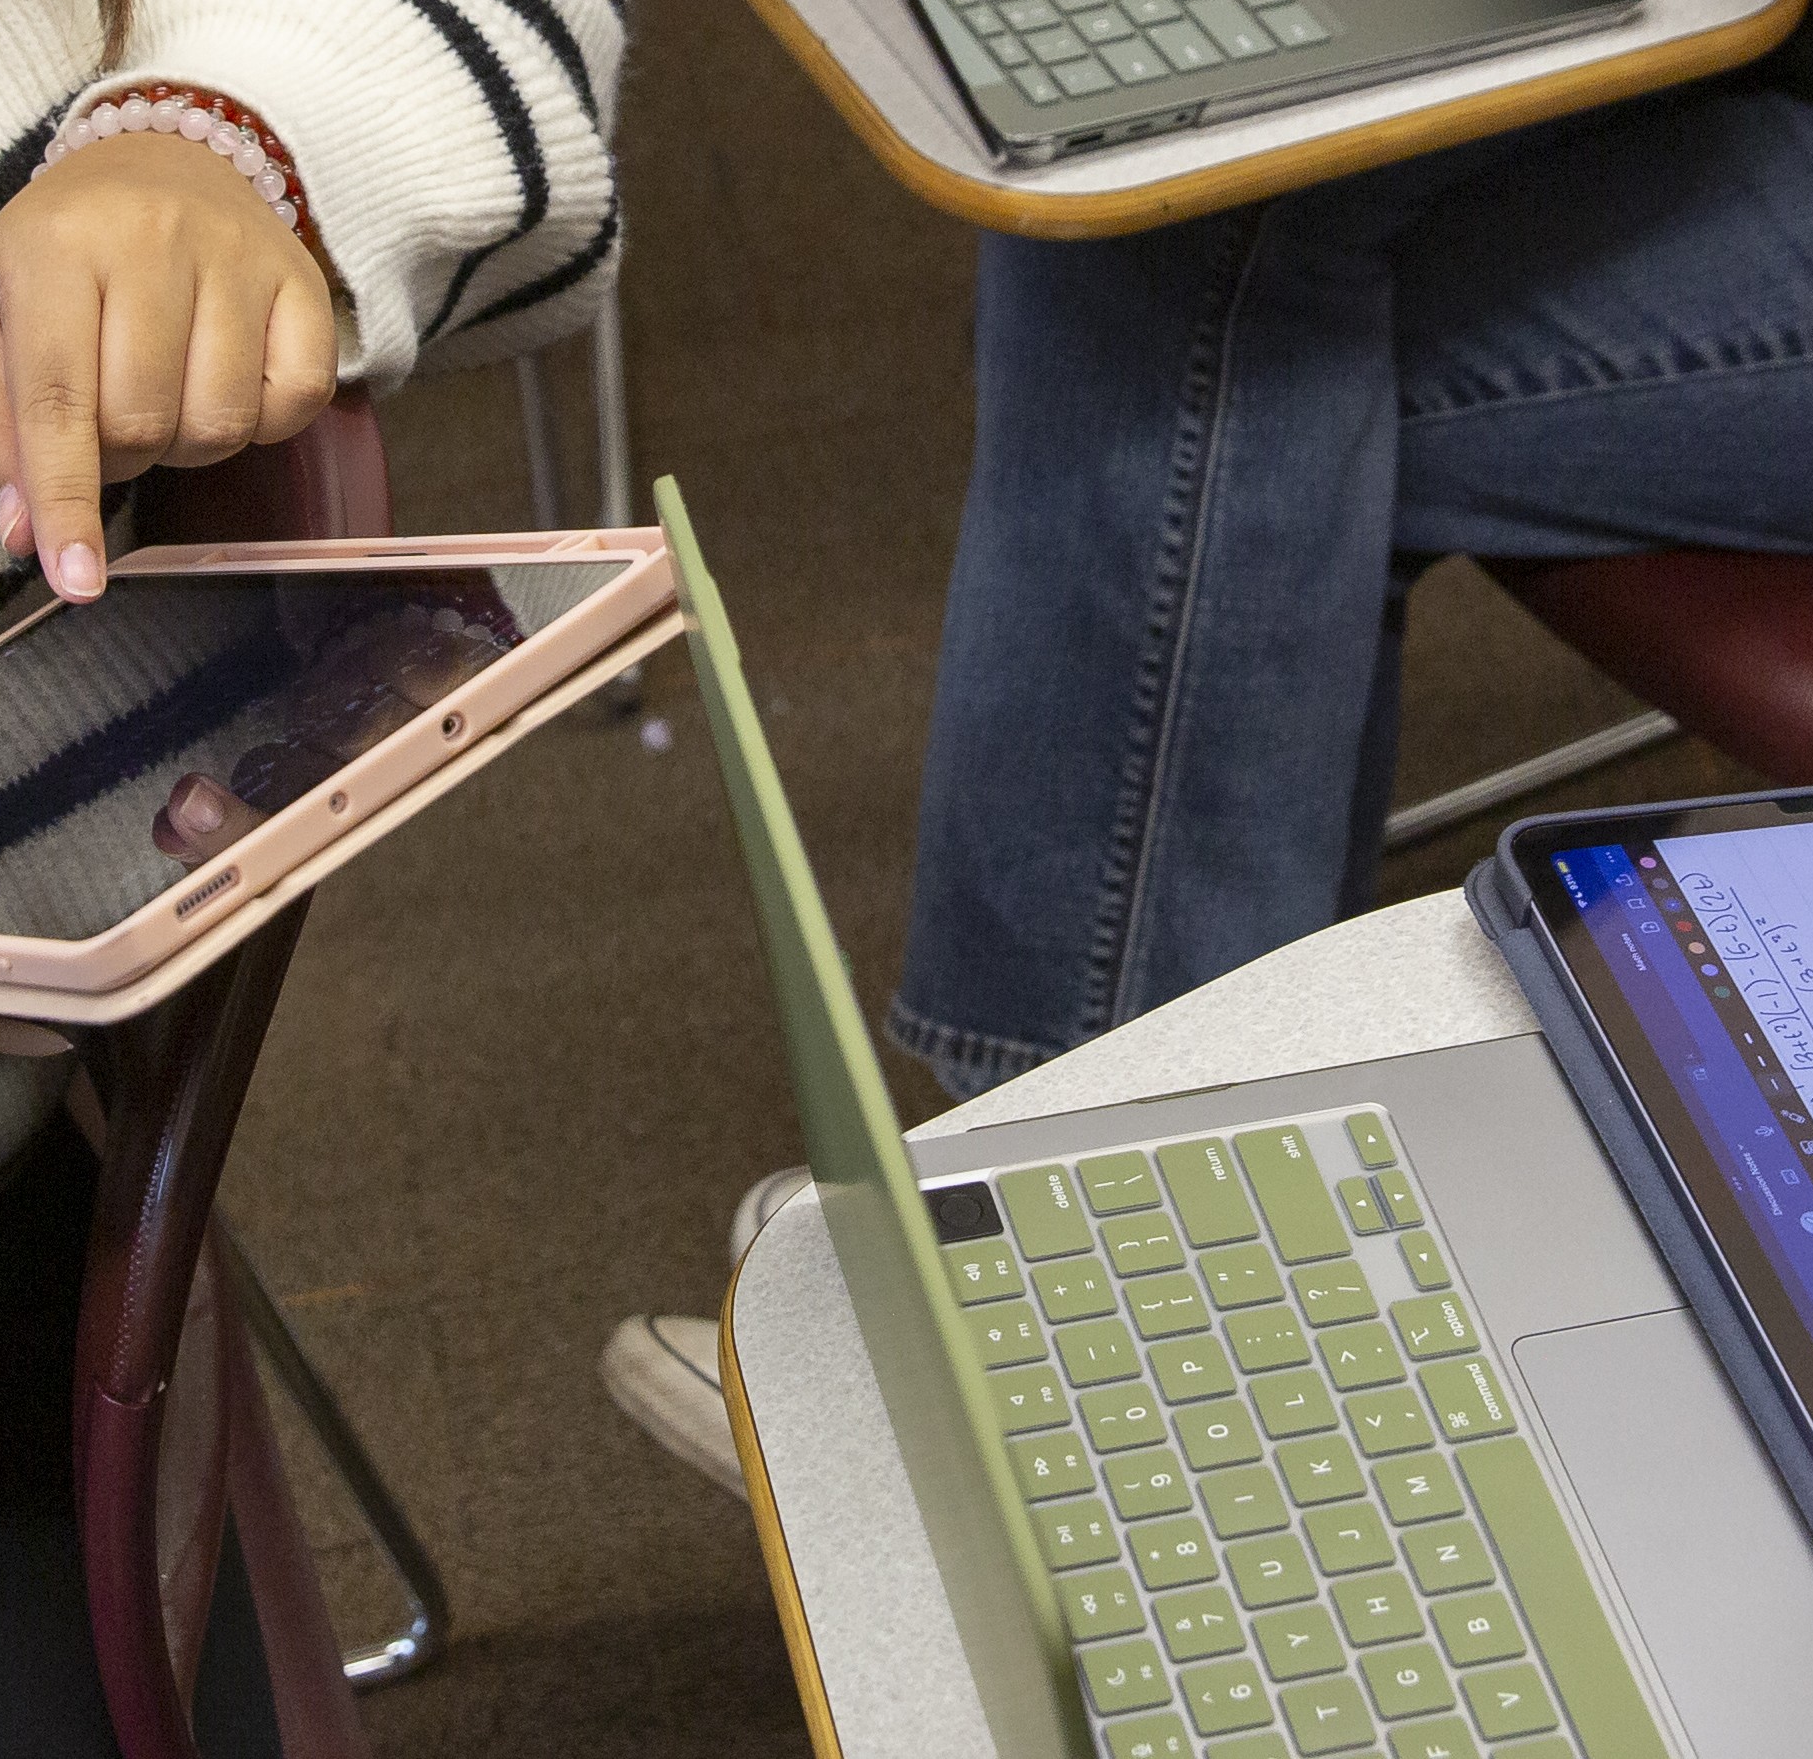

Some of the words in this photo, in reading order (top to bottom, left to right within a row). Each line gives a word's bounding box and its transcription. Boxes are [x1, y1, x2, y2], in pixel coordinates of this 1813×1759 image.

[1621, 933, 1637, 953] notes
[1632, 952, 1647, 971] Math
[1281, 1135, 1300, 1159] shift
[1205, 1147, 1227, 1180] return
[1743, 1152, 1761, 1176] Notes
[1048, 1174, 1069, 1209] delete
[1755, 1175, 1783, 1216] Discussion
[996, 1260, 1008, 1275] F12
[1441, 1300, 1465, 1337] option
[1018, 1323, 1030, 1336] F11
[1182, 1361, 1203, 1373] P
[1040, 1386, 1054, 1402] F10
[1465, 1363, 1503, 1420] command
[1285, 1394, 1304, 1407] L
[1126, 1407, 1146, 1420] 0
[1207, 1424, 1228, 1438] O
[1065, 1455, 1077, 1467] F9
[1310, 1460, 1332, 1475] K
[1151, 1474, 1171, 1487] 9
[1406, 1476, 1430, 1495] M
[1089, 1522, 1102, 1535] F8
[1338, 1530, 1360, 1539] J
[1176, 1541, 1197, 1555] 8
[1436, 1545, 1460, 1562] N
[1260, 1561, 1282, 1576] U
[1114, 1592, 1127, 1604] F7
[1366, 1597, 1390, 1614] H
[1202, 1614, 1223, 1626] 7
[1468, 1618, 1490, 1634] B
[1287, 1634, 1309, 1647] Y
[1396, 1669, 1419, 1686] G
[1230, 1685, 1251, 1699] 6
[1497, 1692, 1520, 1708] V
[1315, 1705, 1339, 1721] T
[1426, 1746, 1450, 1759] F
